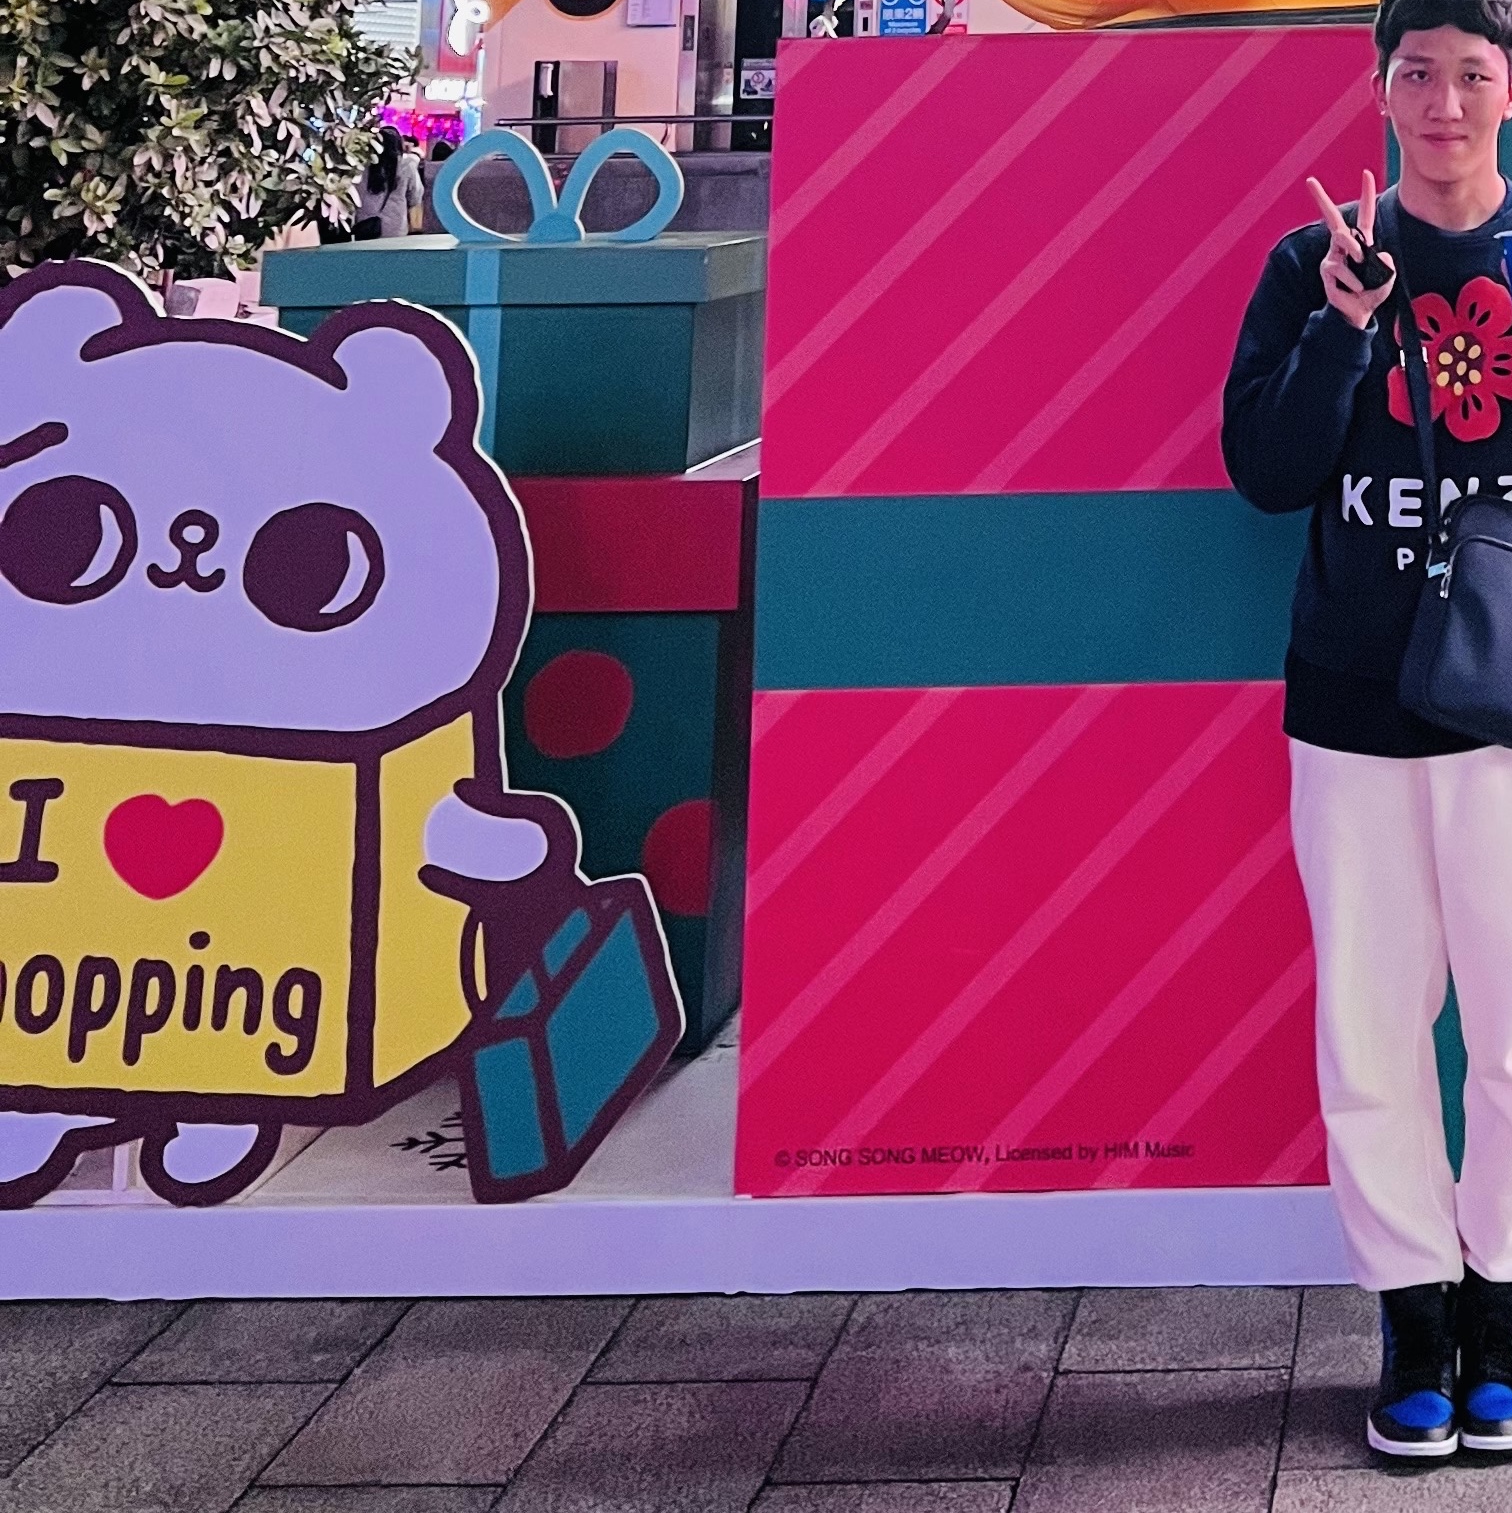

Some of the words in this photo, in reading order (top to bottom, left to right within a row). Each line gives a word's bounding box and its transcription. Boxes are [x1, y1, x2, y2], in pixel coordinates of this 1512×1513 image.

[0, 777, 65, 883] I
[0, 931, 322, 1076] opping
[795, 1148, 853, 1167] SONG
[858, 1147, 916, 1165] SONG
[996, 1144, 1073, 1162] Licensed
[1078, 1144, 1099, 1163] by
[1145, 1141, 1194, 1159] Music
